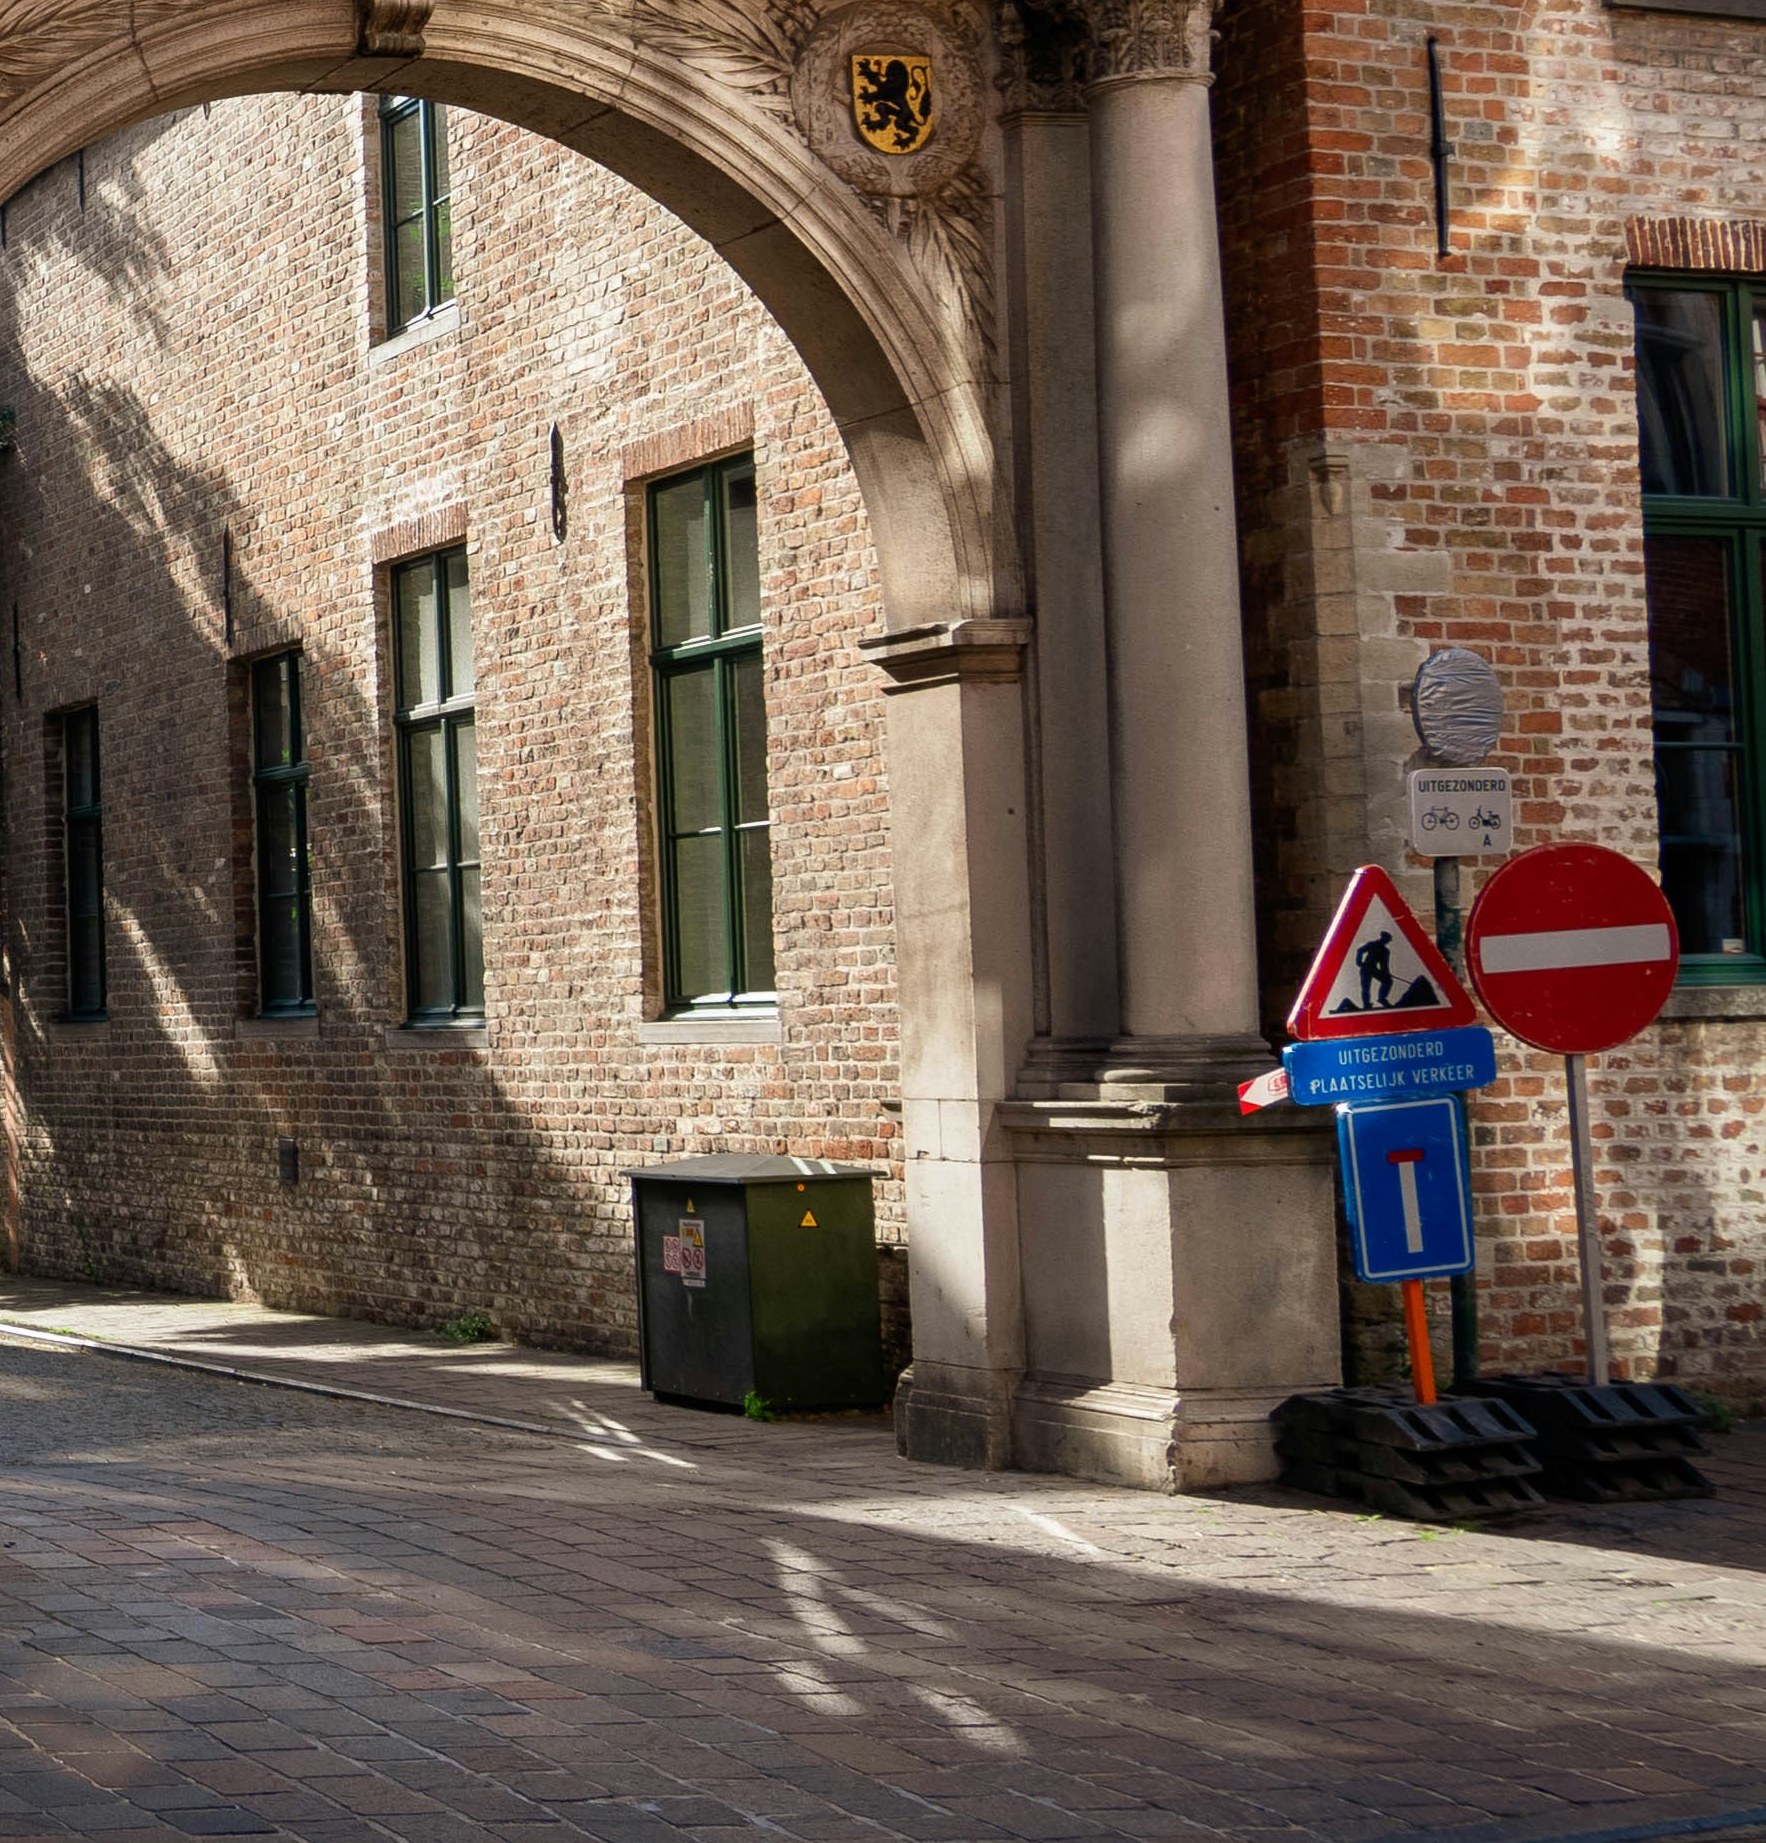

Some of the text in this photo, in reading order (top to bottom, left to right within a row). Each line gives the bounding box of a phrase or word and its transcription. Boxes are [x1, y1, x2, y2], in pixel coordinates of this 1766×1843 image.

[1418, 779, 1506, 793] UITGEZONDERD
[1483, 833, 1492, 847] A
[1338, 1041, 1443, 1065] UITGEZONDERD
[1310, 1071, 1405, 1095] PLAATSELIJK
[1412, 1065, 1474, 1086] VERKEER
